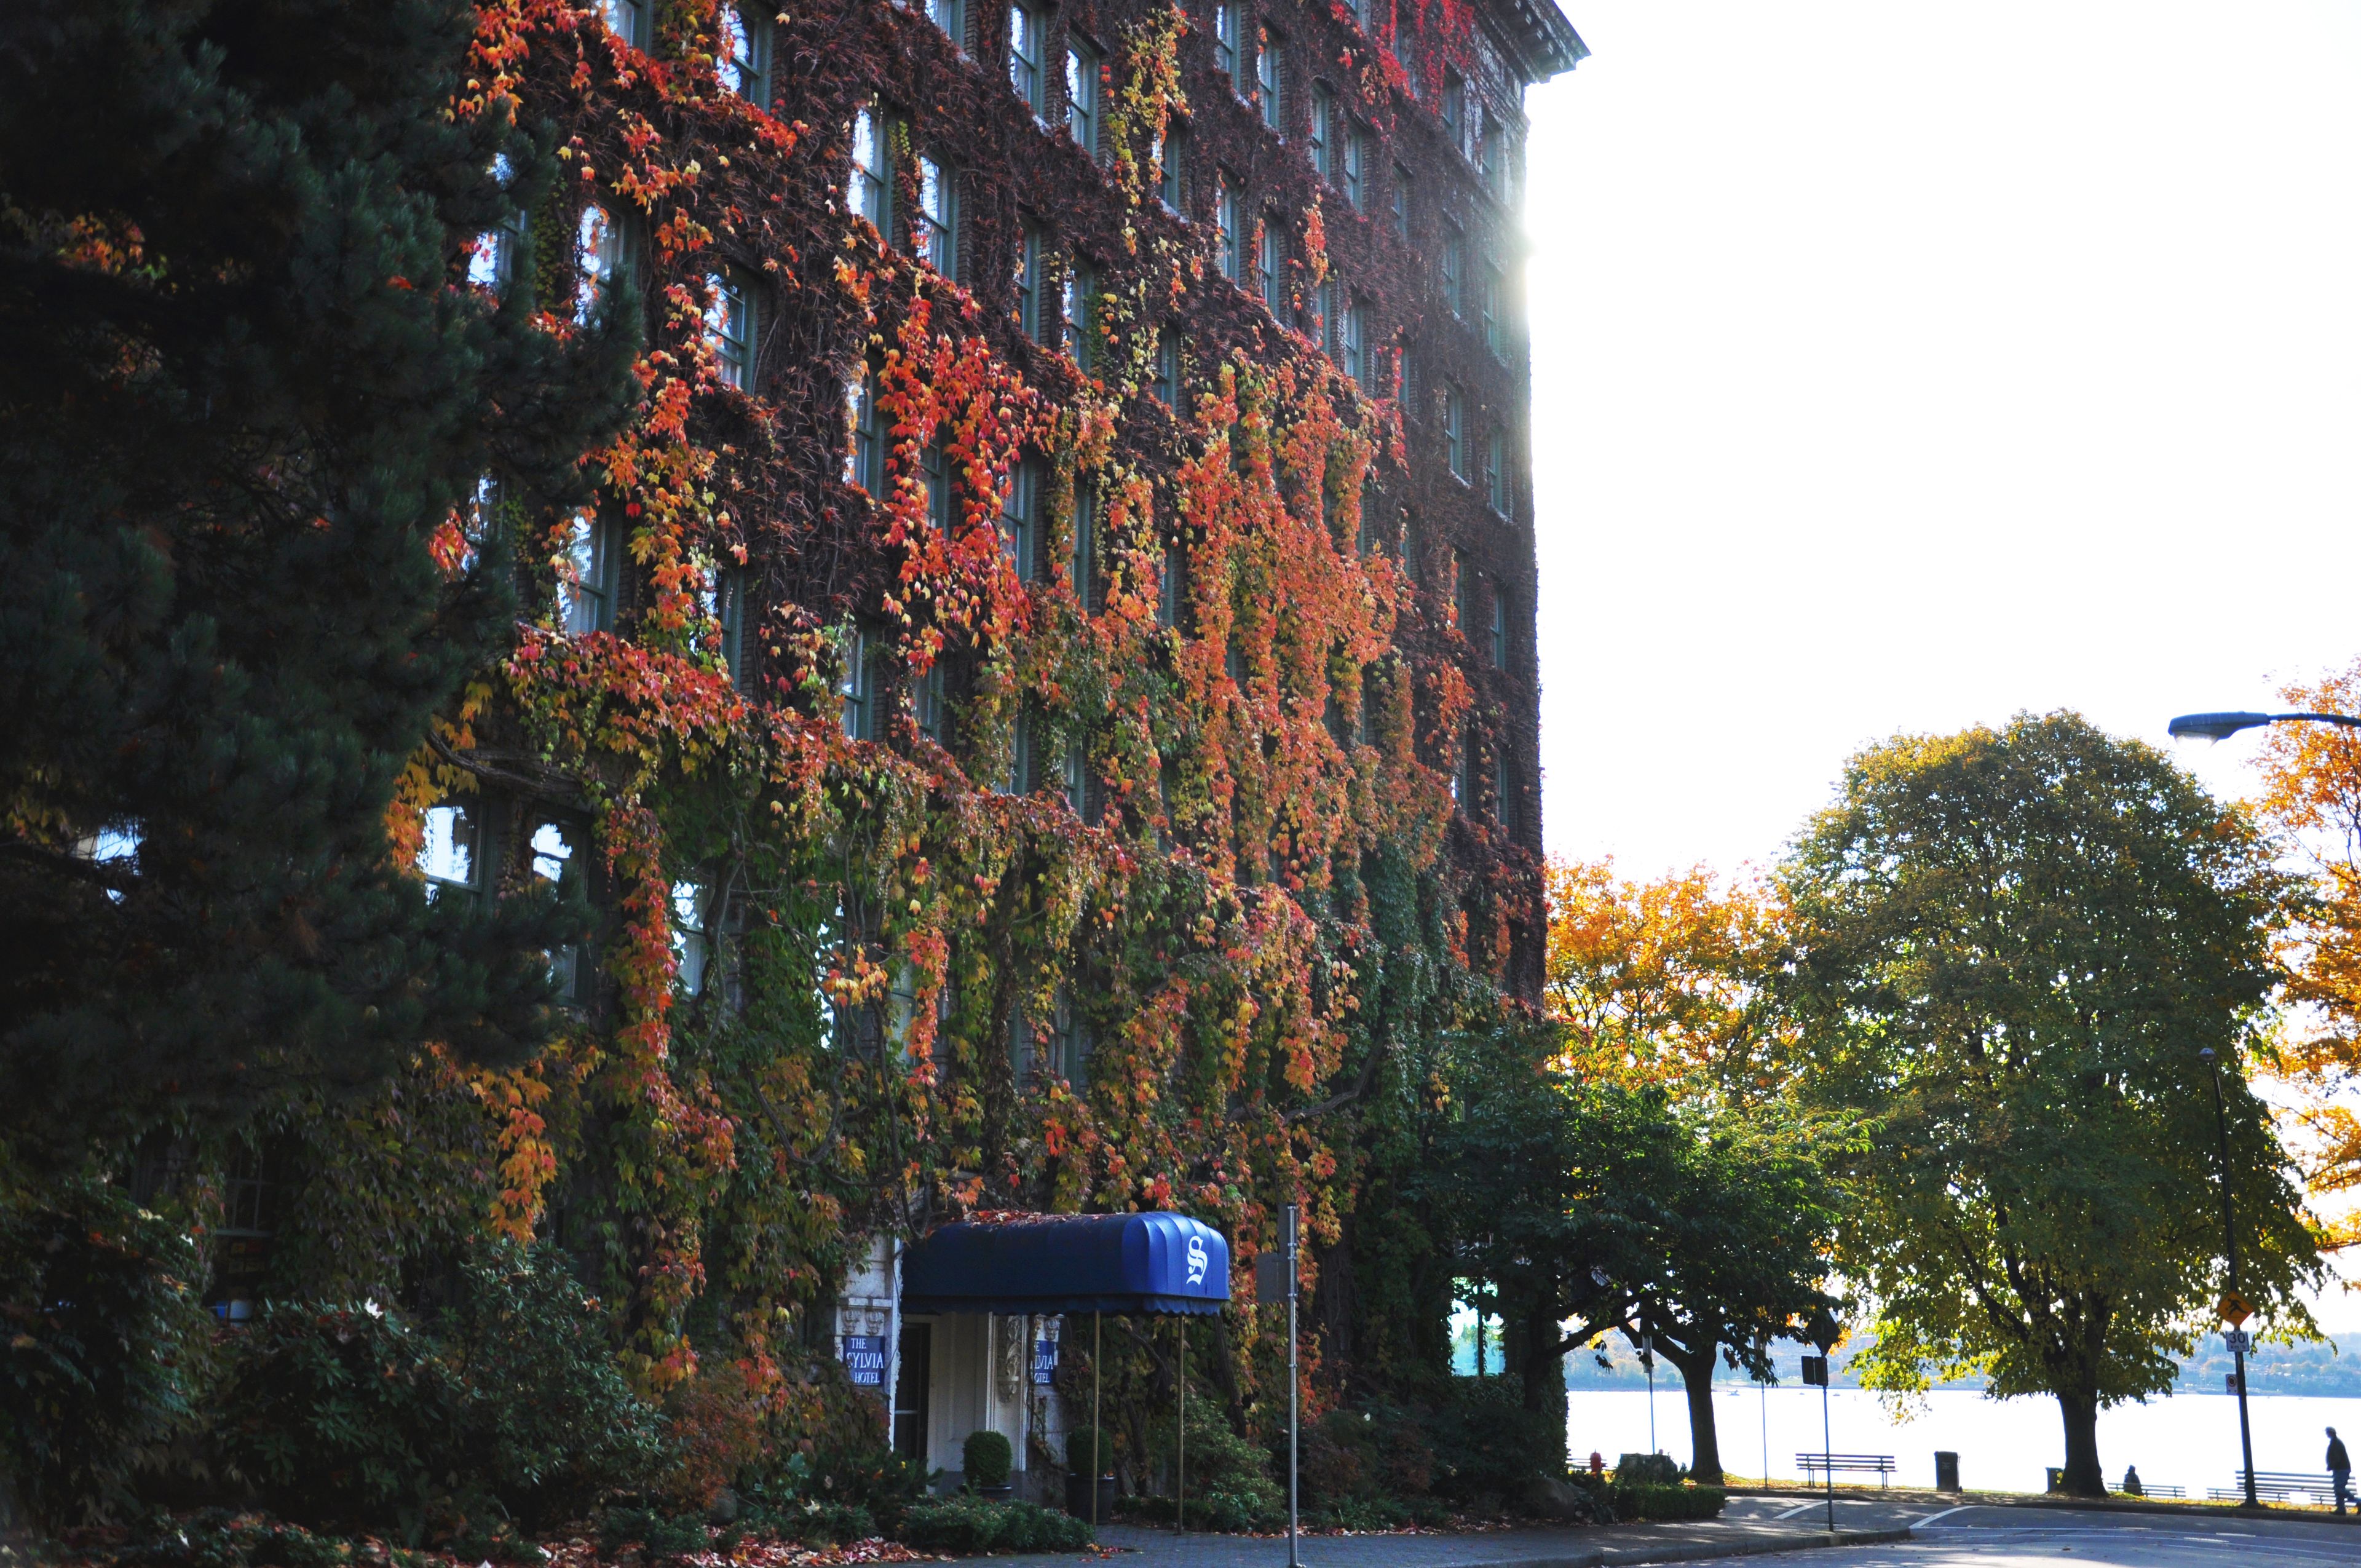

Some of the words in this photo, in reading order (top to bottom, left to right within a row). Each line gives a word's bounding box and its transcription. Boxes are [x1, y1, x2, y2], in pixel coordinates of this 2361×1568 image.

[1186, 1235, 1208, 1285] S
[850, 1338, 866, 1349] THE
[2229, 1332, 2245, 1344] 30
[854, 1372, 880, 1383] HOTEL
[1034, 1372, 1050, 1383] OTEL
